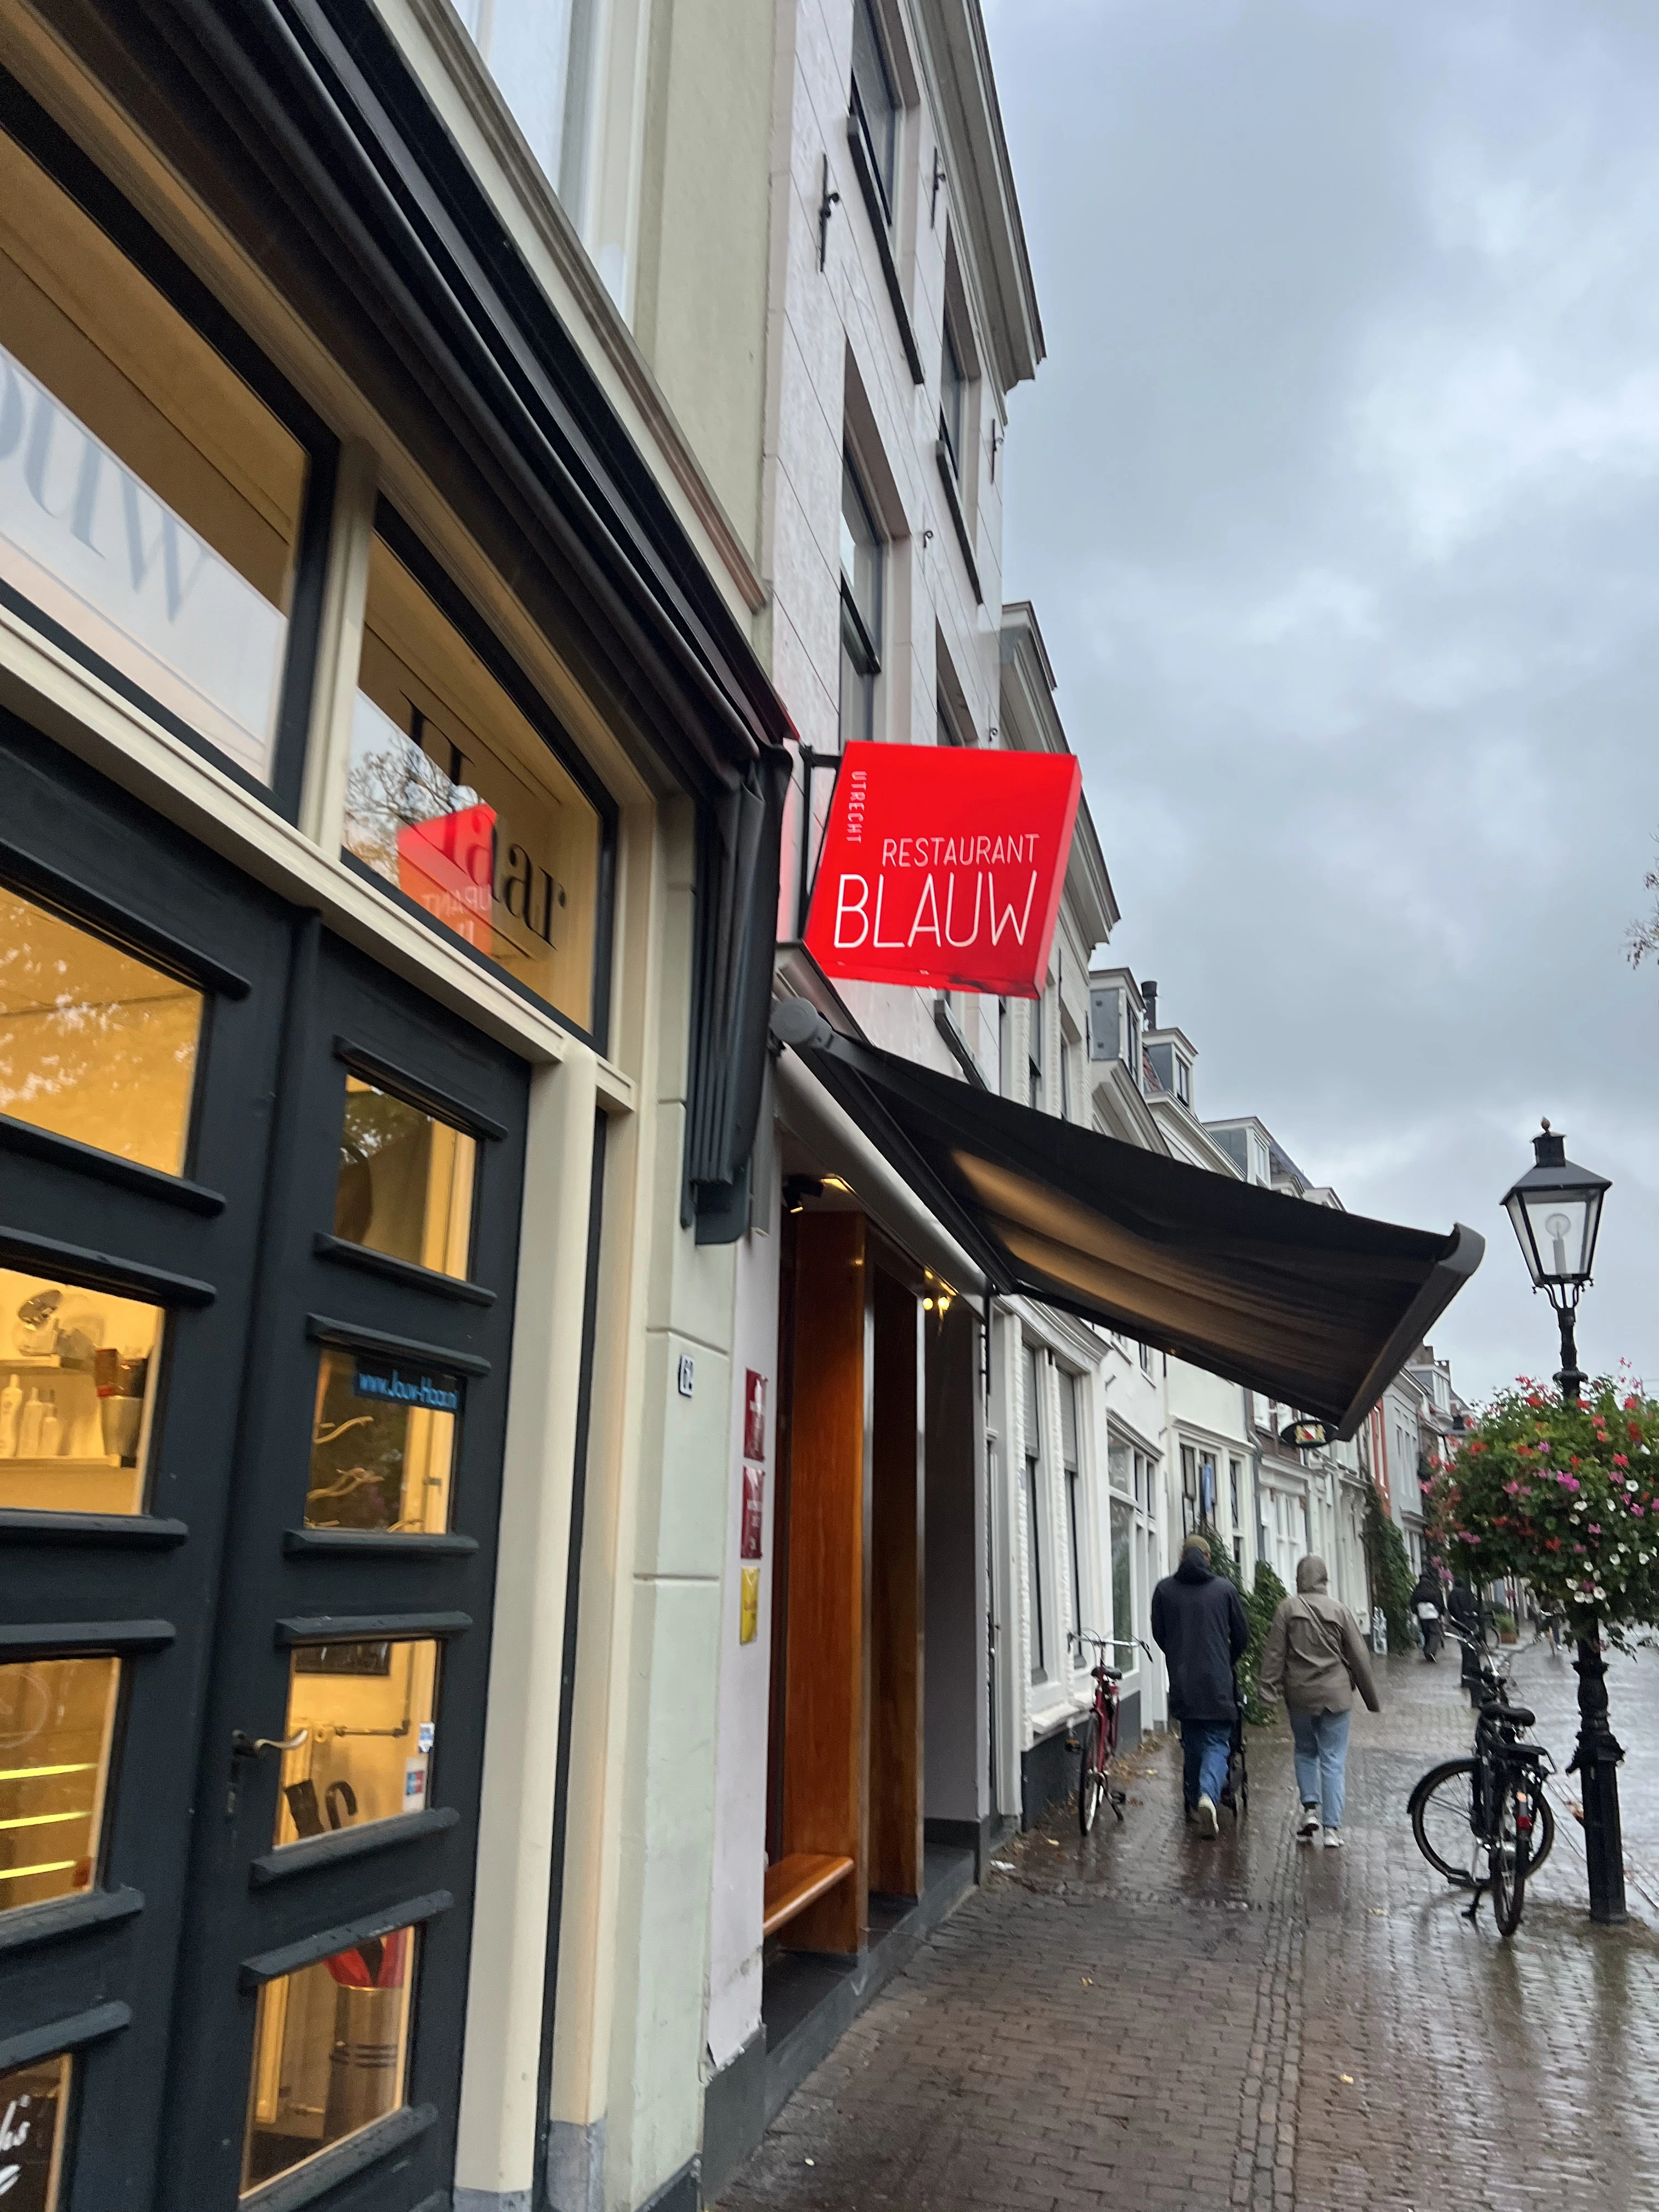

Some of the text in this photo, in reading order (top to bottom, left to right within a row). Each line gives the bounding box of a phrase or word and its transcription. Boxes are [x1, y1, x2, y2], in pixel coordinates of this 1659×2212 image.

[845, 771, 867, 843] UTRECHT
[881, 833, 1040, 868] RESTAURANT
[833, 870, 1038, 949] BLAUW
